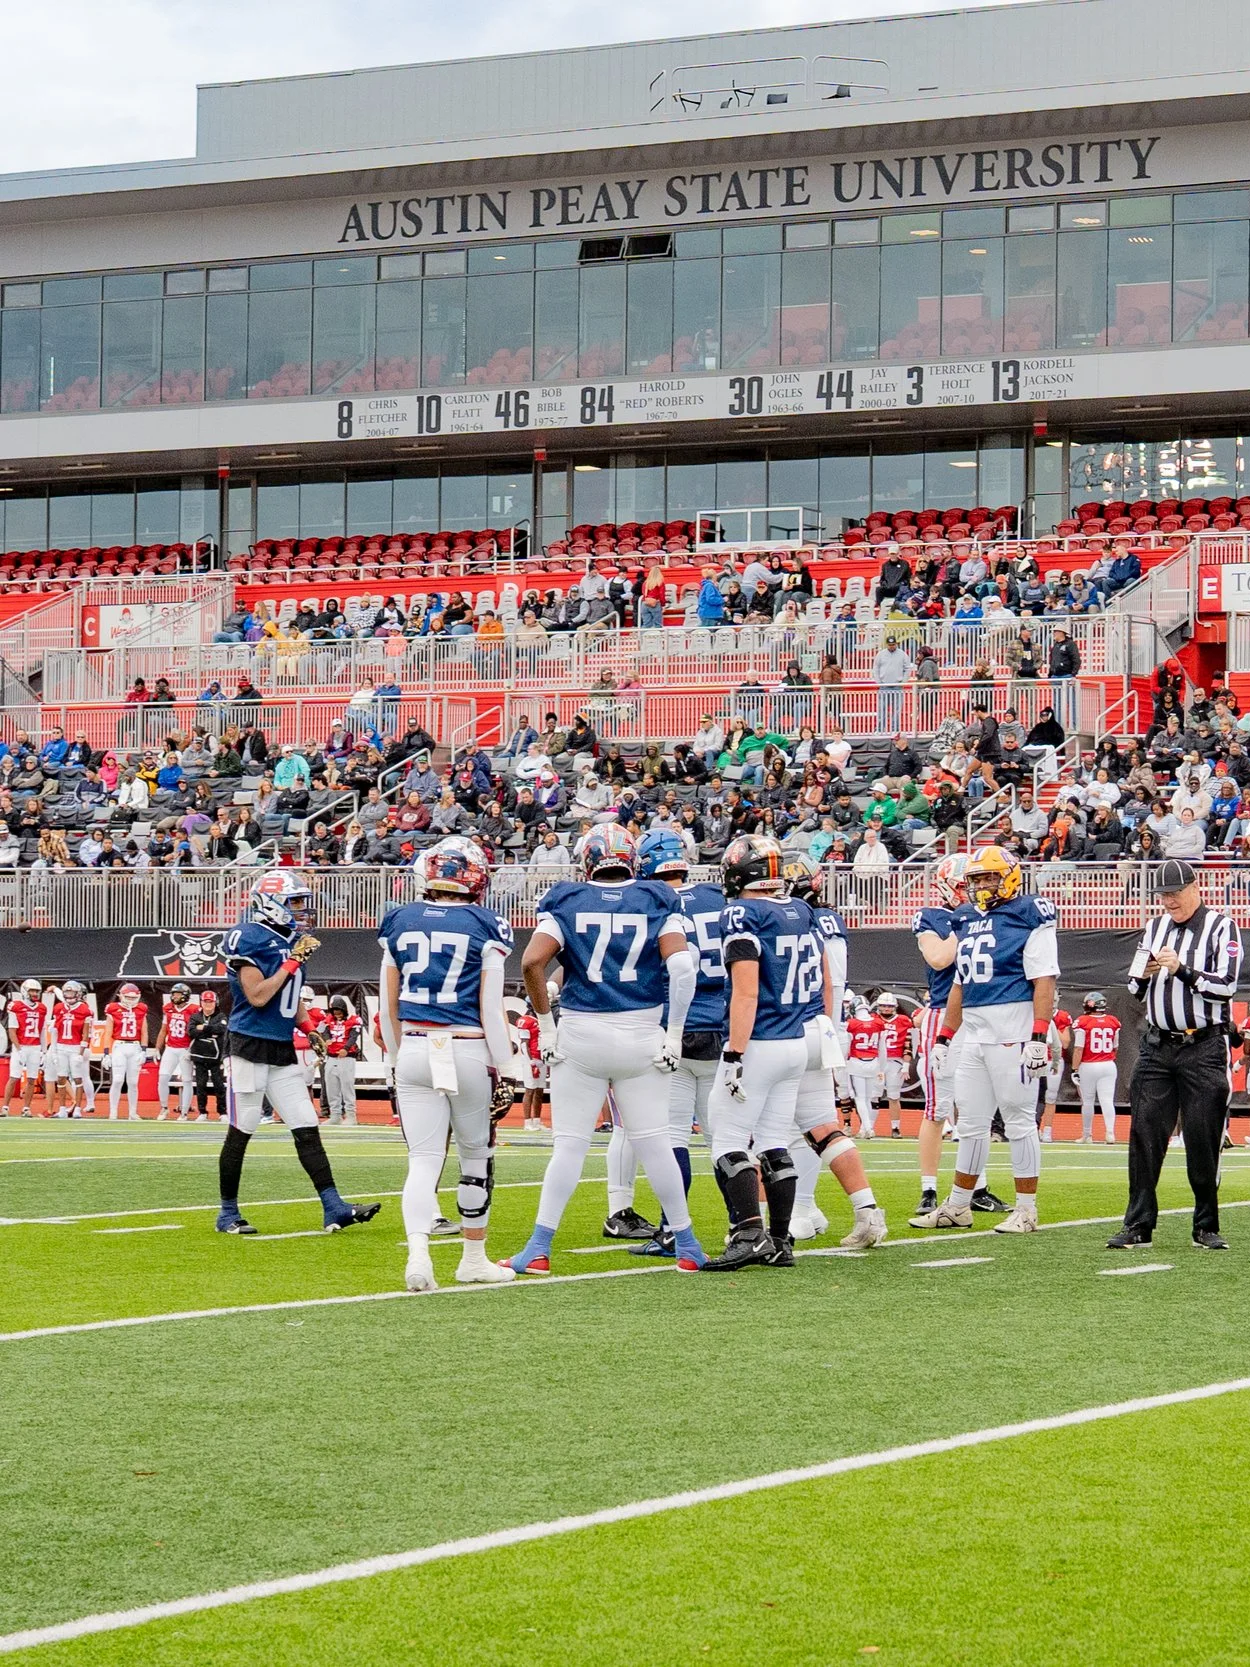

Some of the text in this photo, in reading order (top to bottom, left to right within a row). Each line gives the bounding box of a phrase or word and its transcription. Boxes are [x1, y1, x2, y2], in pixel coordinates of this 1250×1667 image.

[338, 136, 1161, 243] AUSTIN PEAY STATE UNIVERSITY
[928, 363, 985, 376] TERRENCE
[1023, 358, 1076, 371] KORDELL
[771, 374, 801, 386] JOHN
[871, 368, 888, 380] JAY
[991, 359, 1020, 402] 13
[1023, 373, 1074, 387] JACKSON
[639, 381, 685, 393] HAROLD
[816, 370, 854, 410] 44
[860, 382, 898, 394] BAILEY
[906, 366, 924, 406] 3
[941, 379, 973, 390] HOLT
[444, 394, 490, 405] CARLTON
[541, 388, 562, 398] BOB
[656, 395, 705, 407] ROBERTS
[728, 376, 763, 416] 30
[768, 388, 803, 399] OGLES
[937, 394, 975, 405] 2007-10
[1029, 389, 1068, 400] 2017-21
[368, 399, 398, 410] CHRIS
[494, 390, 530, 429] 46
[537, 402, 566, 412] BIBLE
[580, 385, 615, 425] 84
[767, 403, 804, 414] 1963-66
[859, 398, 898, 409] 2000-02
[337, 401, 353, 439] 8
[358, 412, 408, 424] FLETCHER
[416, 395, 442, 434] 10
[452, 408, 482, 419] FLATT
[1202, 578, 1218, 599] E
[84, 617, 97, 637] C
[723, 905, 745, 929] 72
[818, 915, 841, 935] 61
[968, 919, 993, 935] TACA
[575, 913, 647, 983] 77
[397, 931, 470, 1004] 27
[957, 934, 996, 985] 66
[24, 1018, 40, 1038] 21
[62, 1020, 73, 1039] 11
[120, 1017, 137, 1038] 13
[1090, 1027, 1114, 1054] 66
